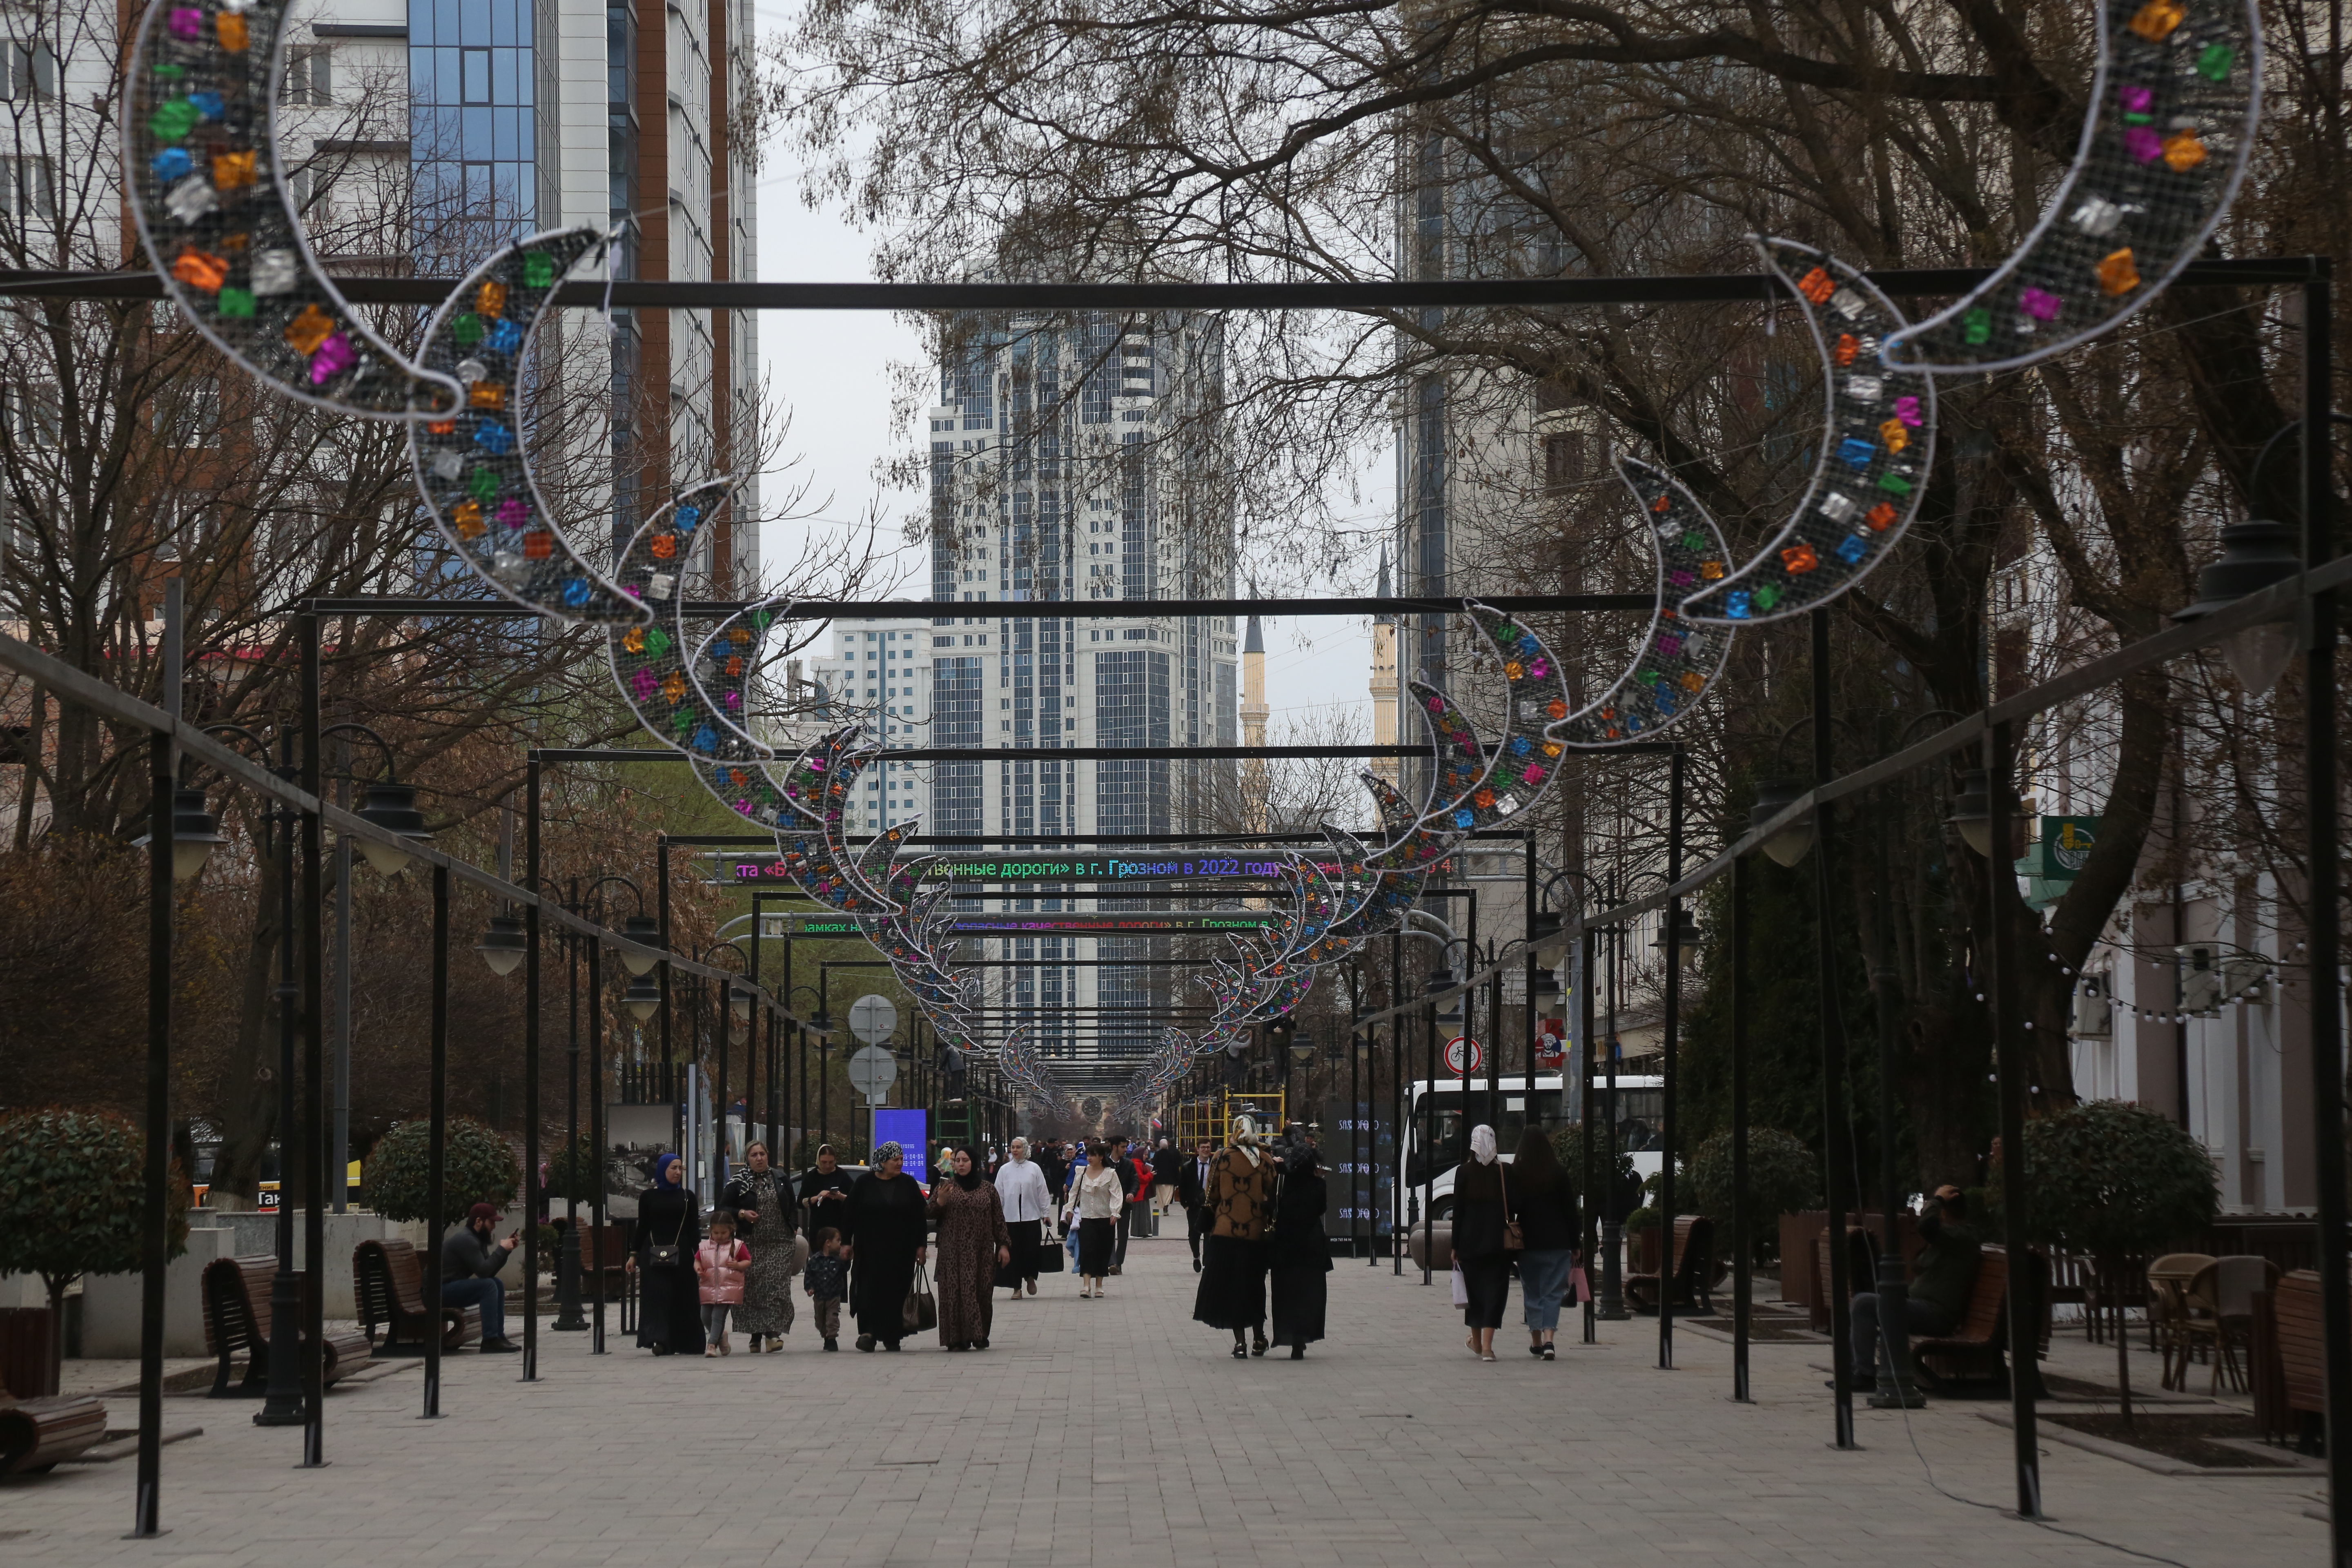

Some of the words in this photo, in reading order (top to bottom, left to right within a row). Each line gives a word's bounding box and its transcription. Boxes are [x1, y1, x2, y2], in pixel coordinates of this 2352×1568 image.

[1001, 863, 1070, 878] дороги»
[1076, 863, 1085, 875] в
[1090, 863, 1102, 875] г.
[1109, 860, 1178, 878] Грозном
[1184, 863, 1193, 874] в
[1199, 860, 1239, 874] 2022
[1245, 862, 1280, 878] году
